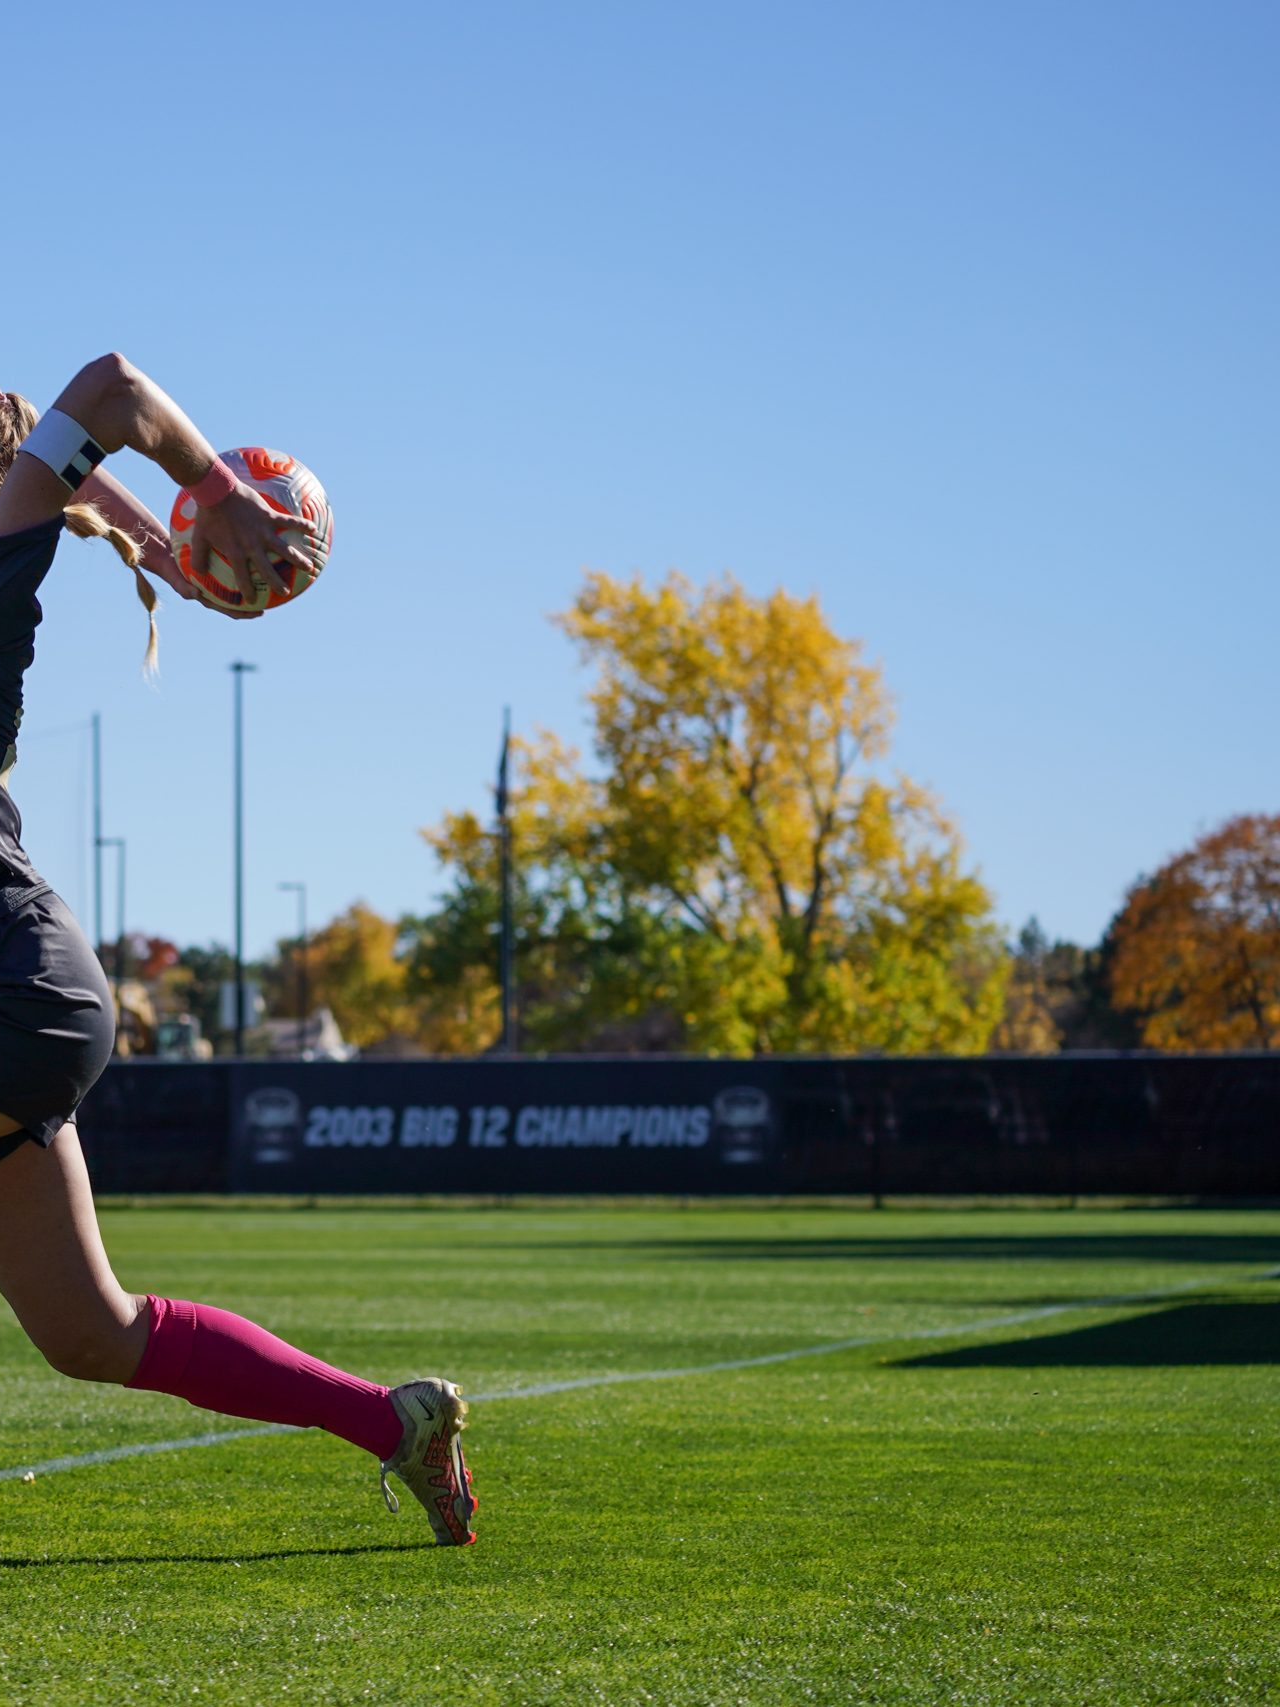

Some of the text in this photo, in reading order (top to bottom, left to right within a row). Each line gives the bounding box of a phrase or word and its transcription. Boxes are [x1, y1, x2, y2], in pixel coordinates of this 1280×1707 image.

[305, 1105, 711, 1147] 2003 BIG 12 CHAMPIONS
